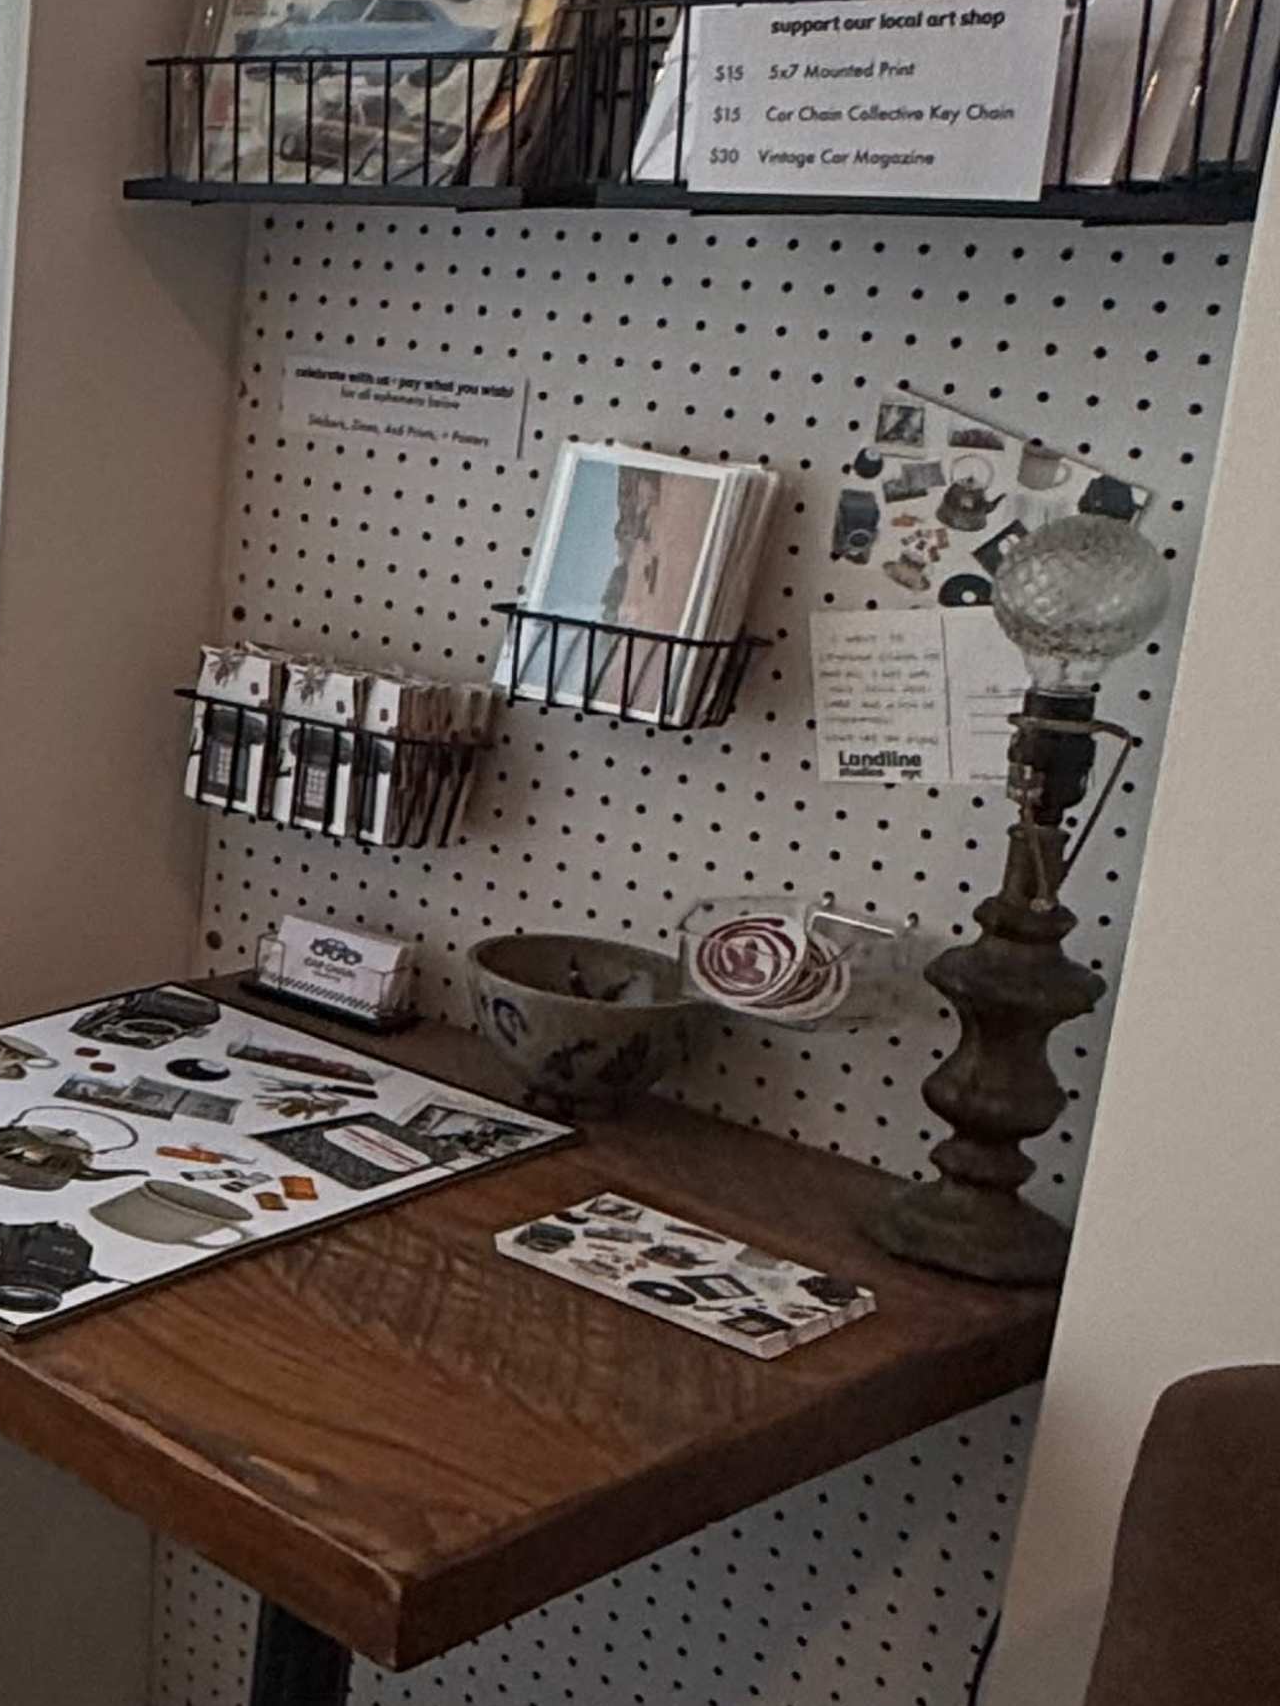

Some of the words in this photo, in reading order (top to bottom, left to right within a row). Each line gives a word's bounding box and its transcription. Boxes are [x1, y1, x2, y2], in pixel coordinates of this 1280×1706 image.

[771, 16, 840, 36] support
[843, 16, 876, 31] our
[880, 11, 922, 29] local
[927, 11, 956, 27] art
[960, 9, 1005, 28] shop
[714, 65, 744, 82] $15
[768, 64, 800, 80] 5x7
[804, 59, 874, 79] Mounted
[879, 61, 915, 77] Print
[713, 106, 741, 124] $15
[766, 106, 793, 122] Car
[798, 105, 842, 121] Chain
[848, 105, 924, 121] Collective
[930, 104, 960, 125] Key
[966, 104, 1015, 120] Chain
[709, 147, 740, 165] $30
[758, 148, 815, 168] Vintage
[820, 148, 849, 164] Car
[853, 149, 935, 169] Magazine
[398, 378, 421, 391] pay
[424, 379, 454, 392] what
[456, 385, 479, 396] you
[839, 750, 922, 767] Landline
